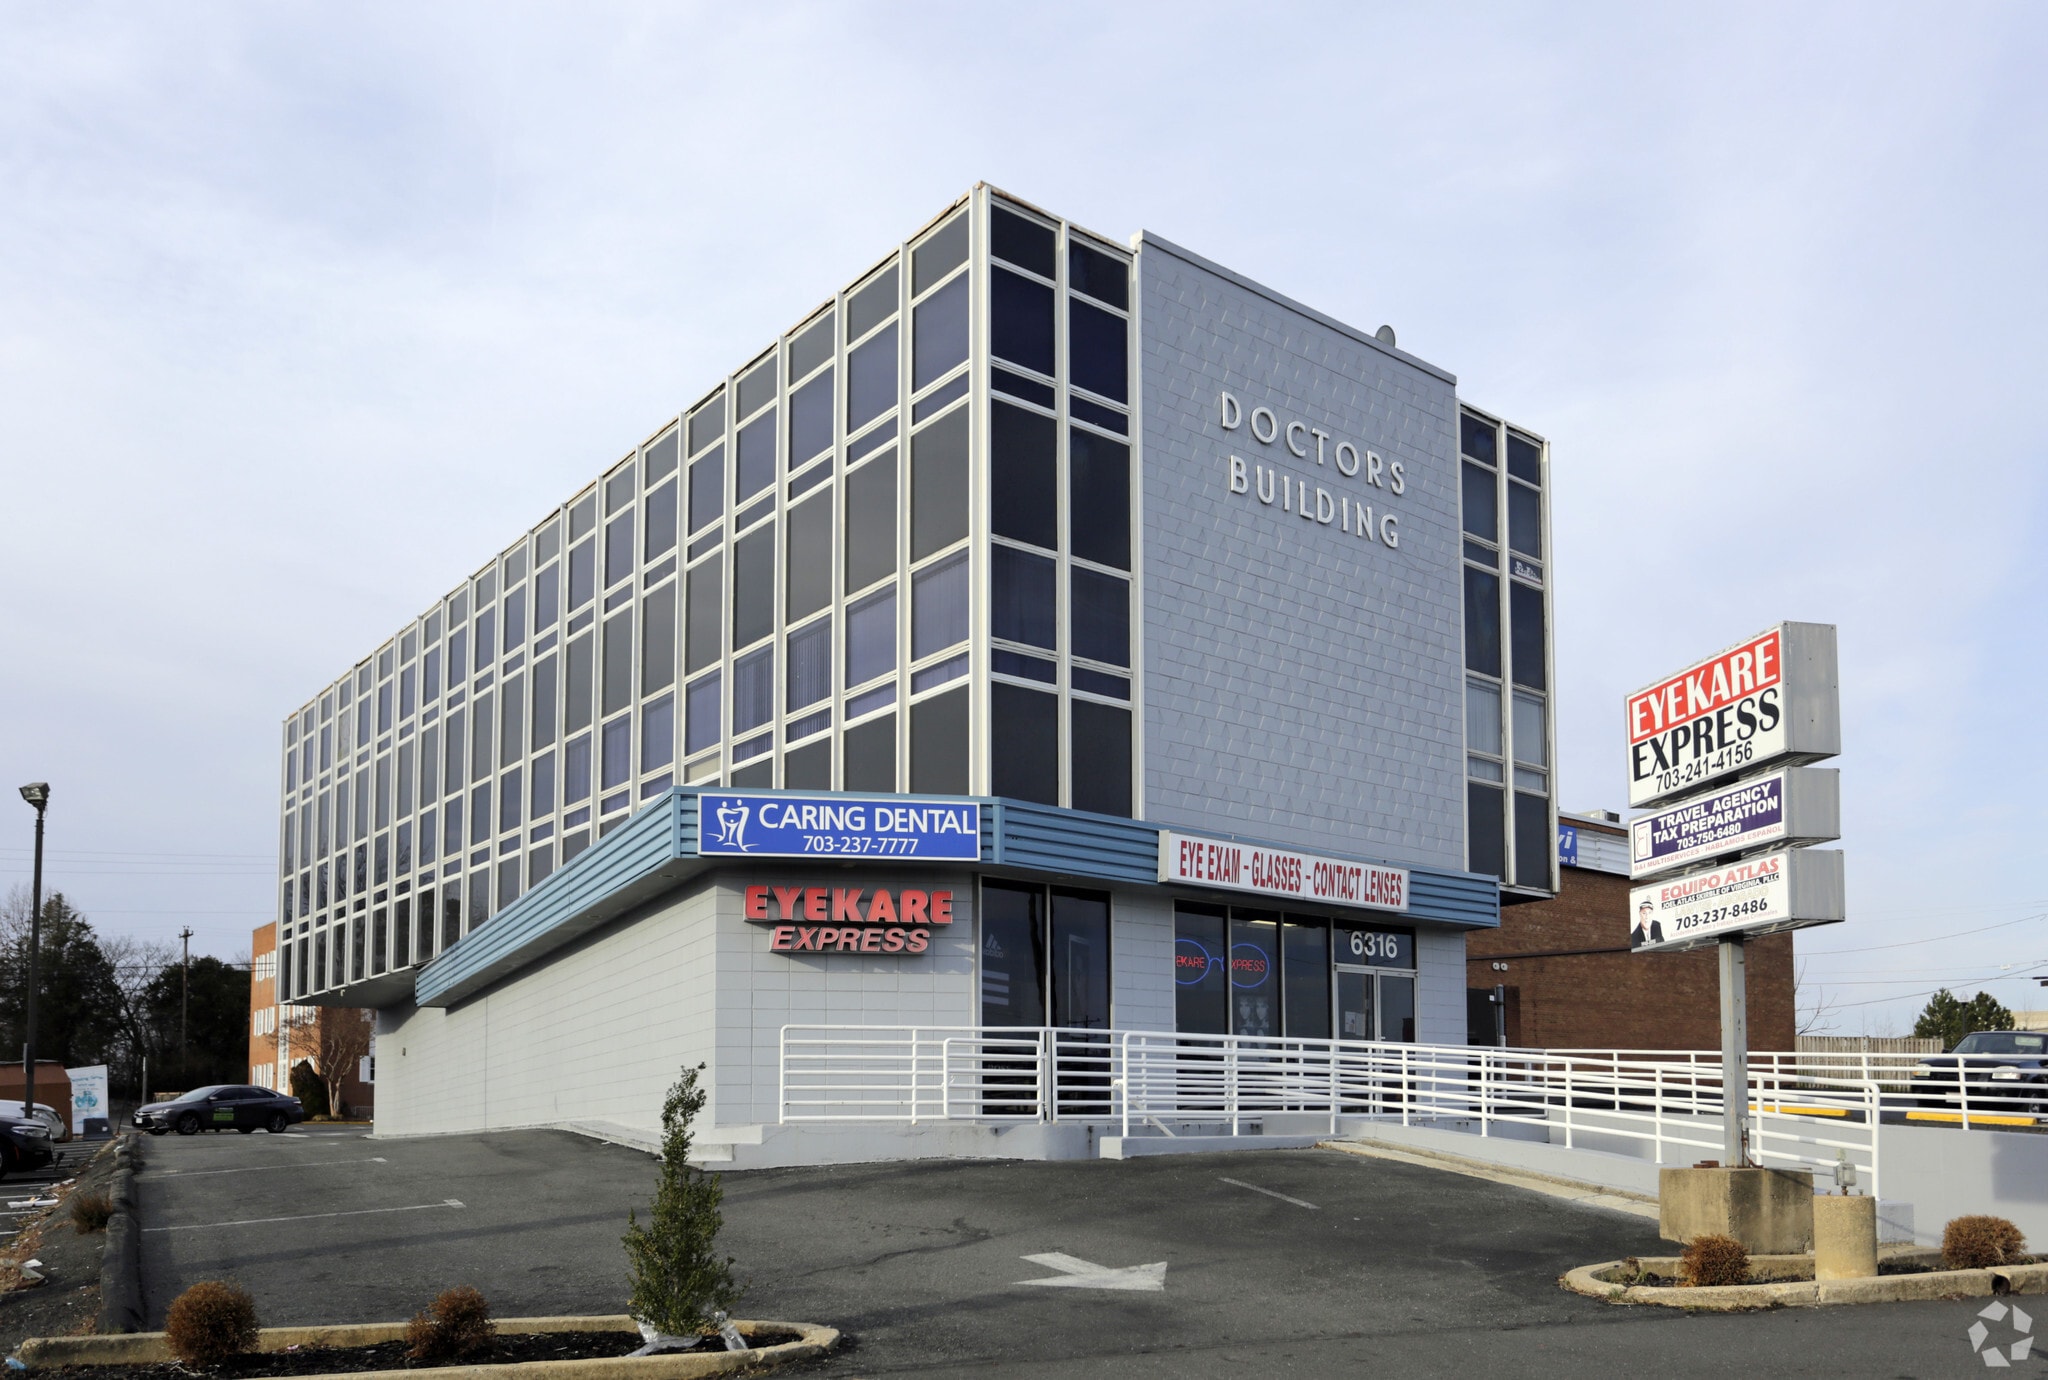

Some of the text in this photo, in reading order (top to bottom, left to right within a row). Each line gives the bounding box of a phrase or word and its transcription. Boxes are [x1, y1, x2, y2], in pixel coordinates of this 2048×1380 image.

[1221, 391, 1405, 495] DOCTORS
[1229, 454, 1399, 549] BUILDING
[1632, 637, 1777, 739] EYEKARE
[1632, 687, 1780, 782] EXPRESS
[1656, 741, 1753, 793] 703-241-4156
[758, 803, 976, 835] CARING DENTAL
[1653, 826, 1678, 844] TAX
[1681, 795, 1778, 840] PREPARATION
[1658, 783, 1772, 829] TRAVEL AGENCY
[803, 834, 919, 855] 703-237-7777
[1648, 847, 1700, 869] MULTISERVICES
[1705, 835, 1745, 851] HABLAMOS
[1747, 824, 1783, 841] ESPAÑOL
[1677, 822, 1741, 850] 703-750-6480
[1179, 840, 1204, 879] EYE
[1207, 845, 1241, 884] EXAM
[1251, 851, 1302, 893] GLASSES
[1313, 861, 1363, 901] CONTACT
[1364, 871, 1402, 907] LENSES
[1661, 858, 1779, 902] EQUIPO ATLAS
[1661, 900, 1677, 910] JOEL
[1677, 896, 1695, 907] ATLAS
[1721, 886, 1730, 895] OF
[1763, 872, 1779, 882] PLLC
[743, 884, 953, 924] EYEKARE
[1676, 897, 1768, 931] 703-237-8486
[771, 925, 931, 953] EXPRESS
[1350, 931, 1398, 958] 6316
